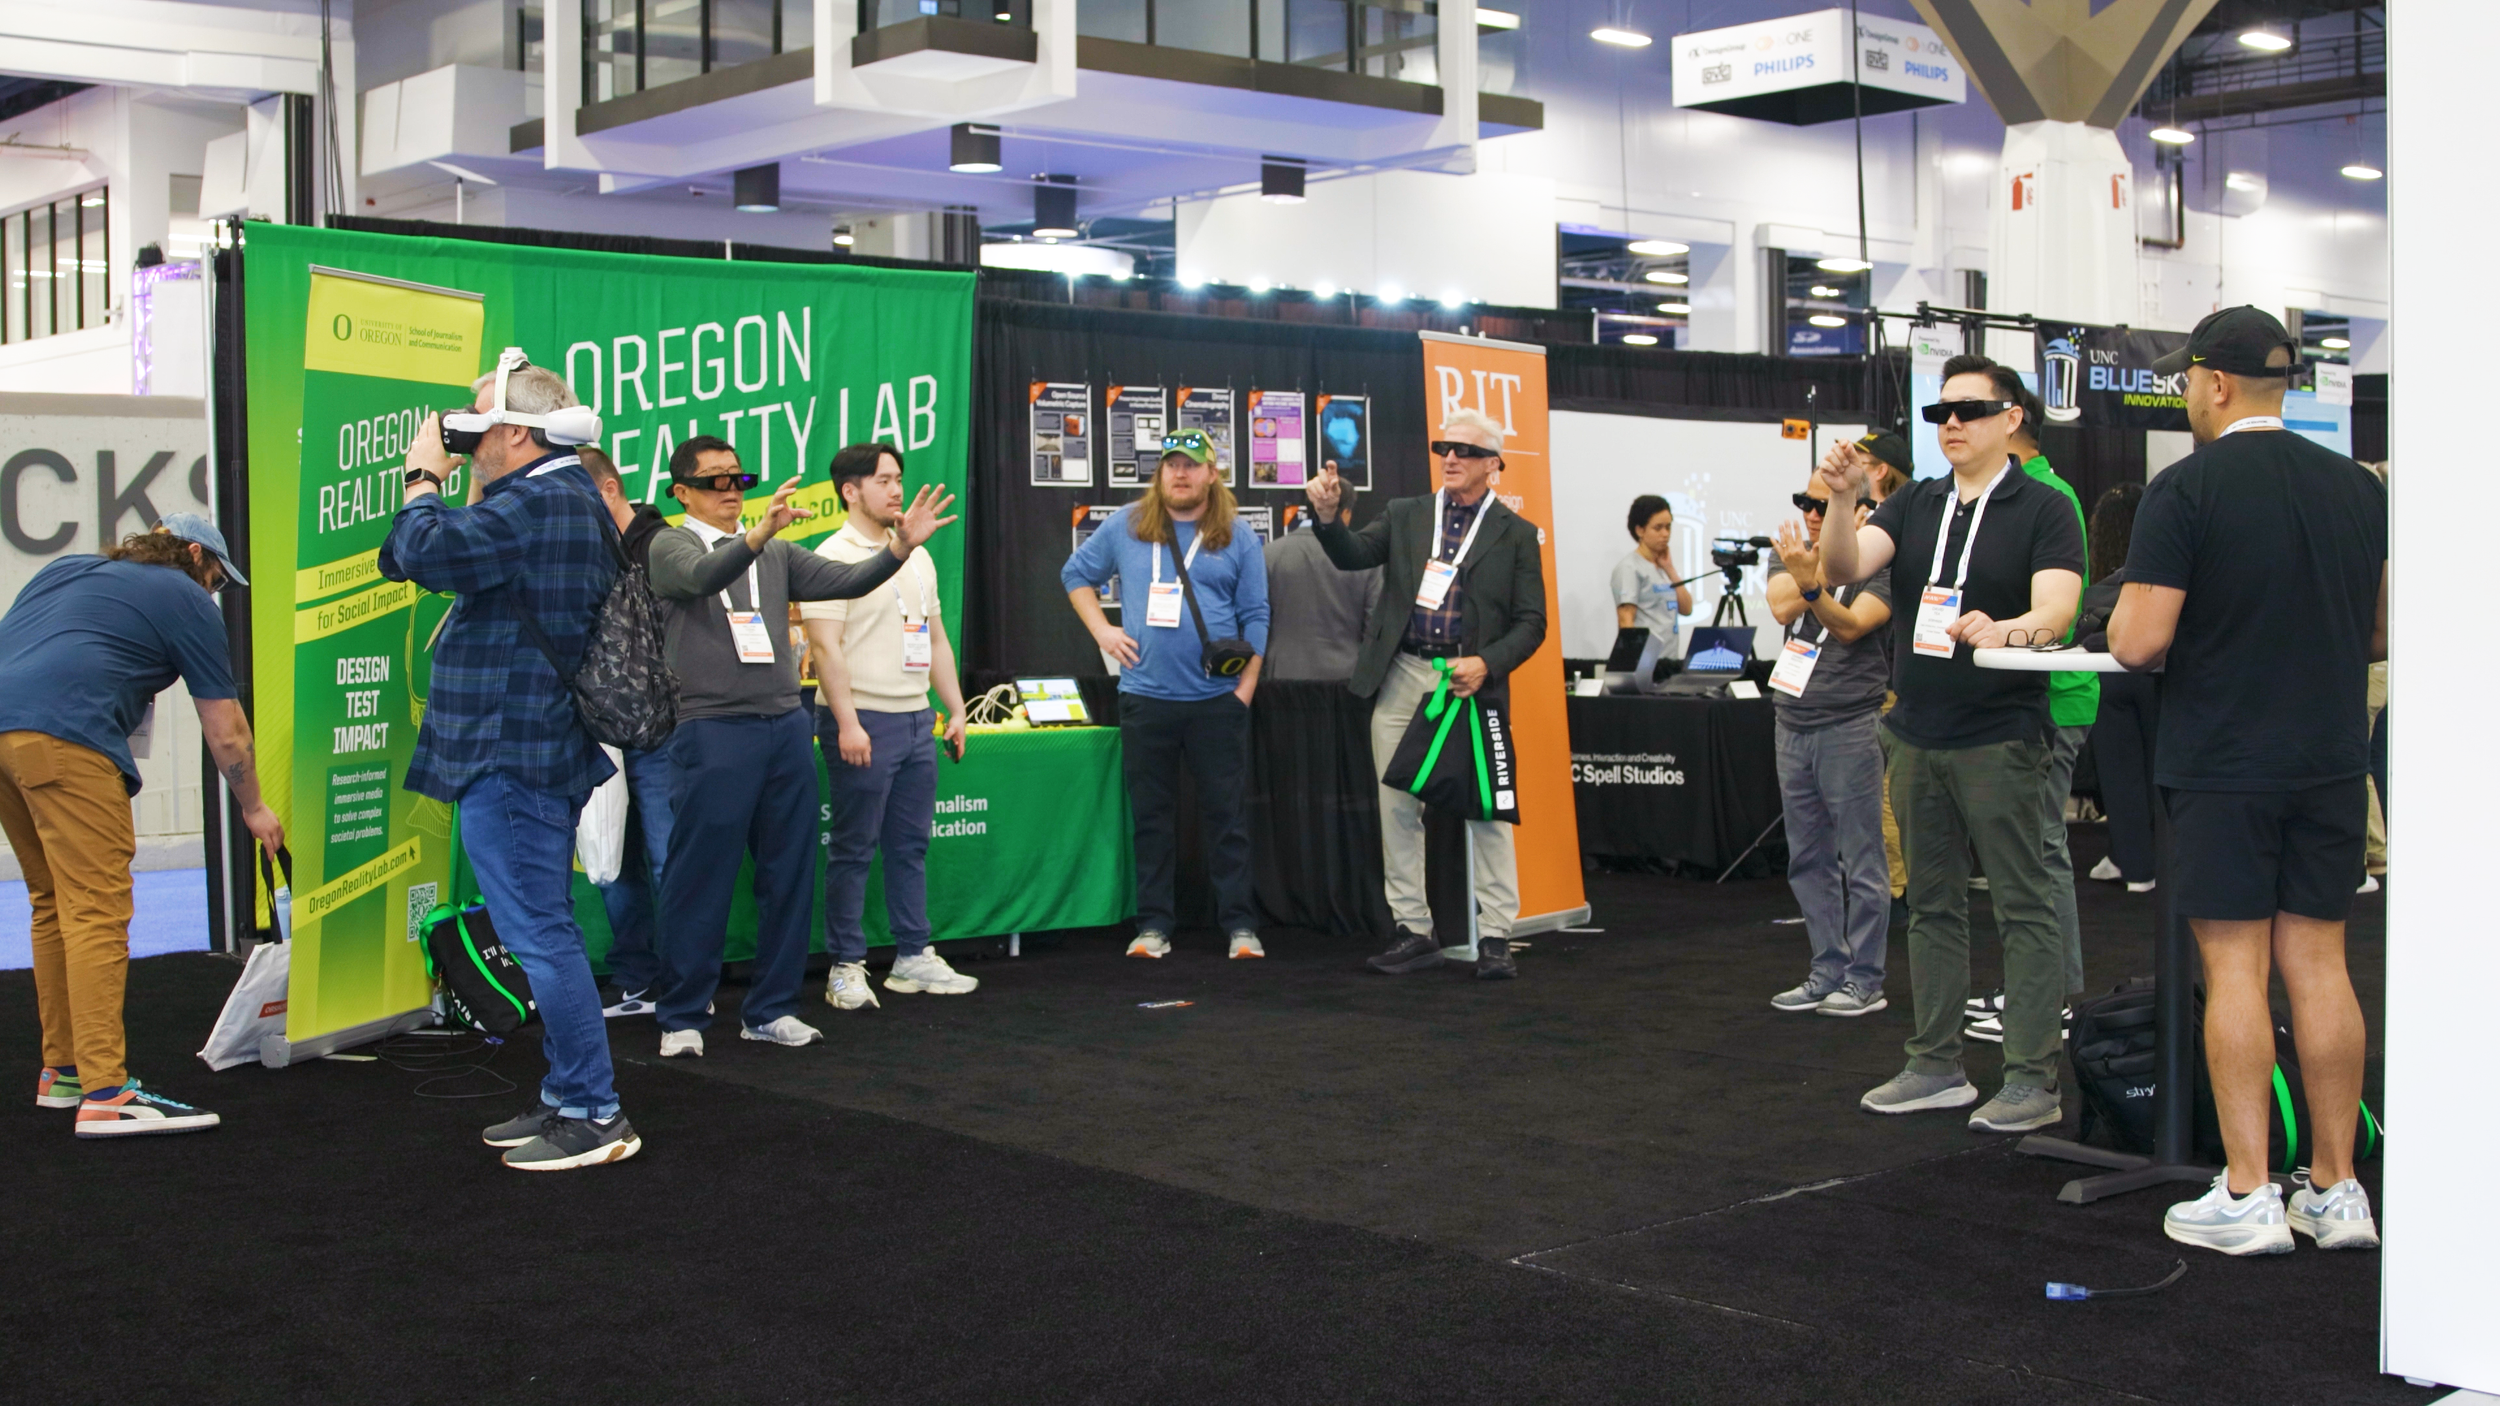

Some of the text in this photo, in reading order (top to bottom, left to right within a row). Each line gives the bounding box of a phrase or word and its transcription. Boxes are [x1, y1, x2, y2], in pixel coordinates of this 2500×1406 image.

[1754, 53, 1815, 76] PHILIPS
[1904, 60, 1948, 82] PHILIPS
[333, 313, 352, 341] O
[360, 318, 394, 330] UNIVERSITY
[409, 326, 463, 341] School of Journalism
[360, 328, 402, 346] OREGON
[408, 340, 462, 352] and Communication
[565, 306, 812, 417] OREGON
[2090, 349, 2119, 365] UNC
[1434, 365, 1521, 437] RIT
[1496, 489, 1524, 513] esign
[1719, 510, 1753, 527] UNC
[318, 557, 376, 590] Immersive
[317, 584, 408, 631] for Social Impact
[336, 656, 390, 686] DESIGN
[345, 690, 380, 719] TEST
[333, 722, 389, 754] IMPACT
[1487, 709, 1510, 786] RIVERSIDE
[1641, 752, 1676, 765] Creativity
[331, 768, 387, 786] Research-informed
[1583, 763, 1622, 787] Spell
[1622, 764, 1685, 785] Studios
[334, 788, 384, 805] immersive media
[333, 806, 382, 824] to solve complex
[330, 825, 384, 844] societal problems.
[308, 851, 408, 915] OregonRealityLab.com
